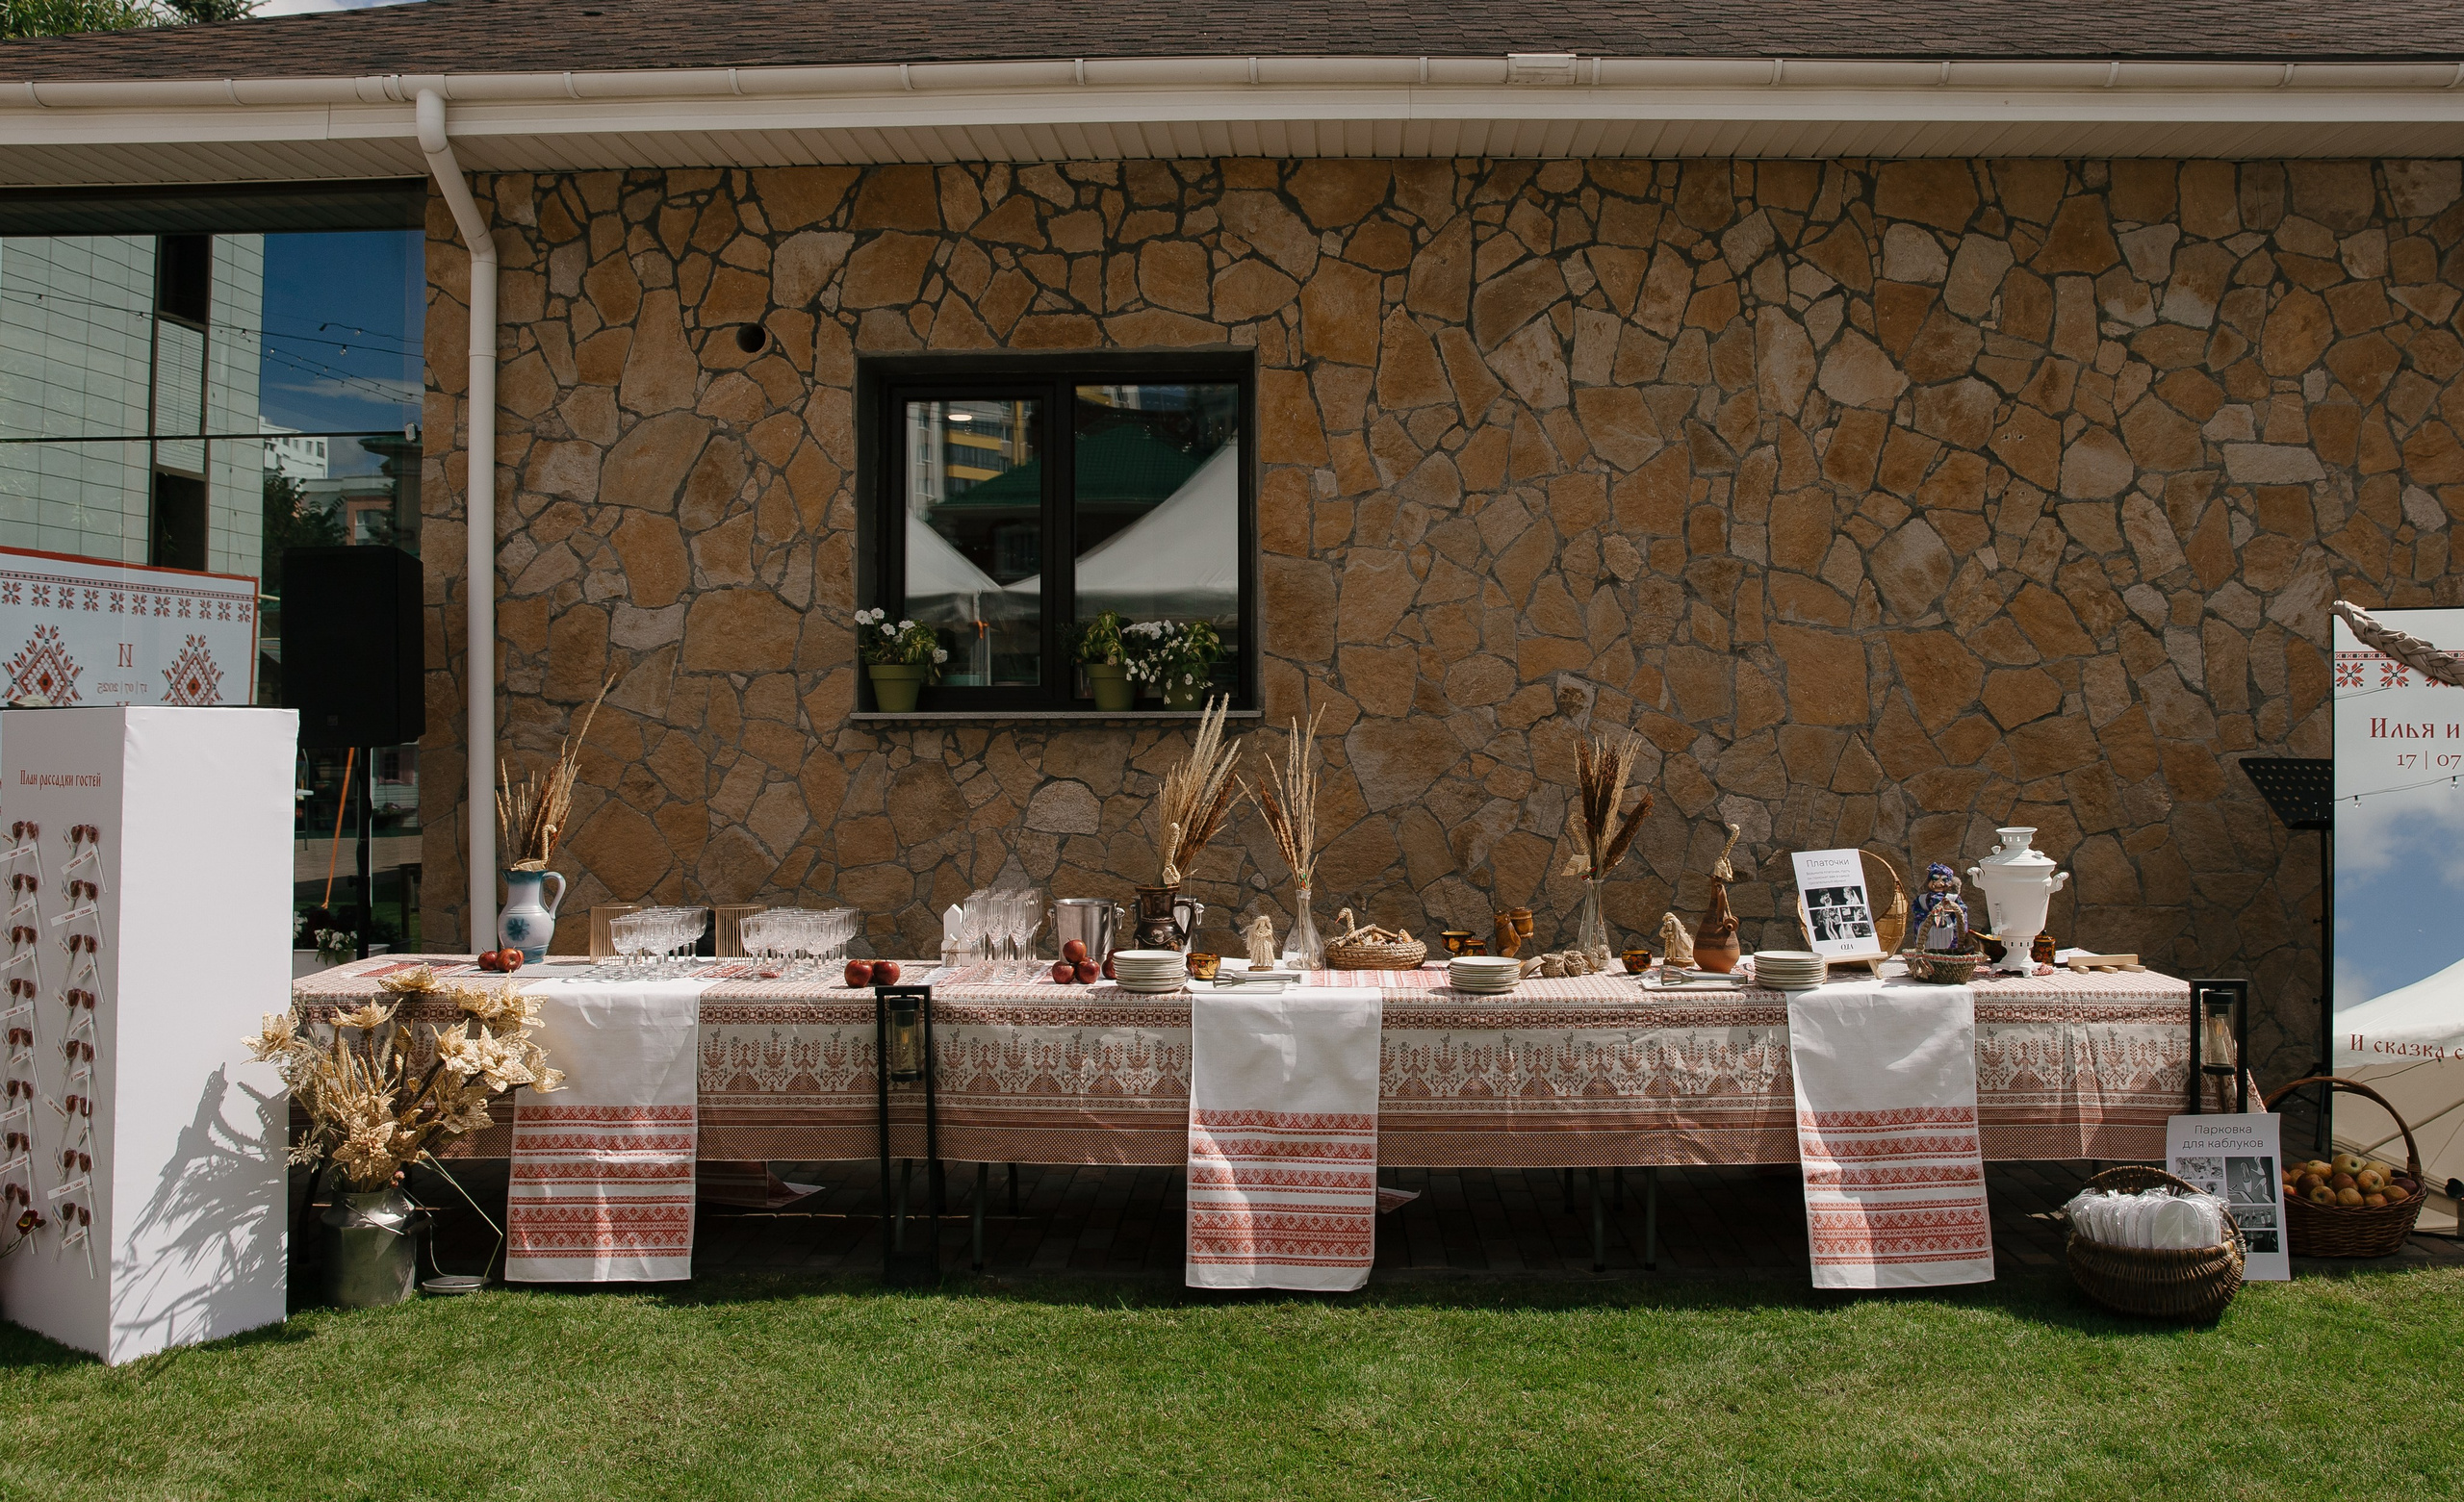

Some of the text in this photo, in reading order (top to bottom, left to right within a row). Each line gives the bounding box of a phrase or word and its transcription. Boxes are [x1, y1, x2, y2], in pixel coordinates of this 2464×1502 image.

[2370, 717, 2460, 739] Илья и
[2397, 753, 2417, 770] 17
[2436, 753, 2462, 770] 07
[20, 769, 101, 791] План рассадки гостей
[1806, 858, 1850, 868] Платочки
[2349, 1033, 2364, 1052] И
[2374, 1040, 2445, 1059] сказка
[2194, 1124, 2253, 1136] Парковка
[2182, 1137, 2265, 1151] для каблуков
